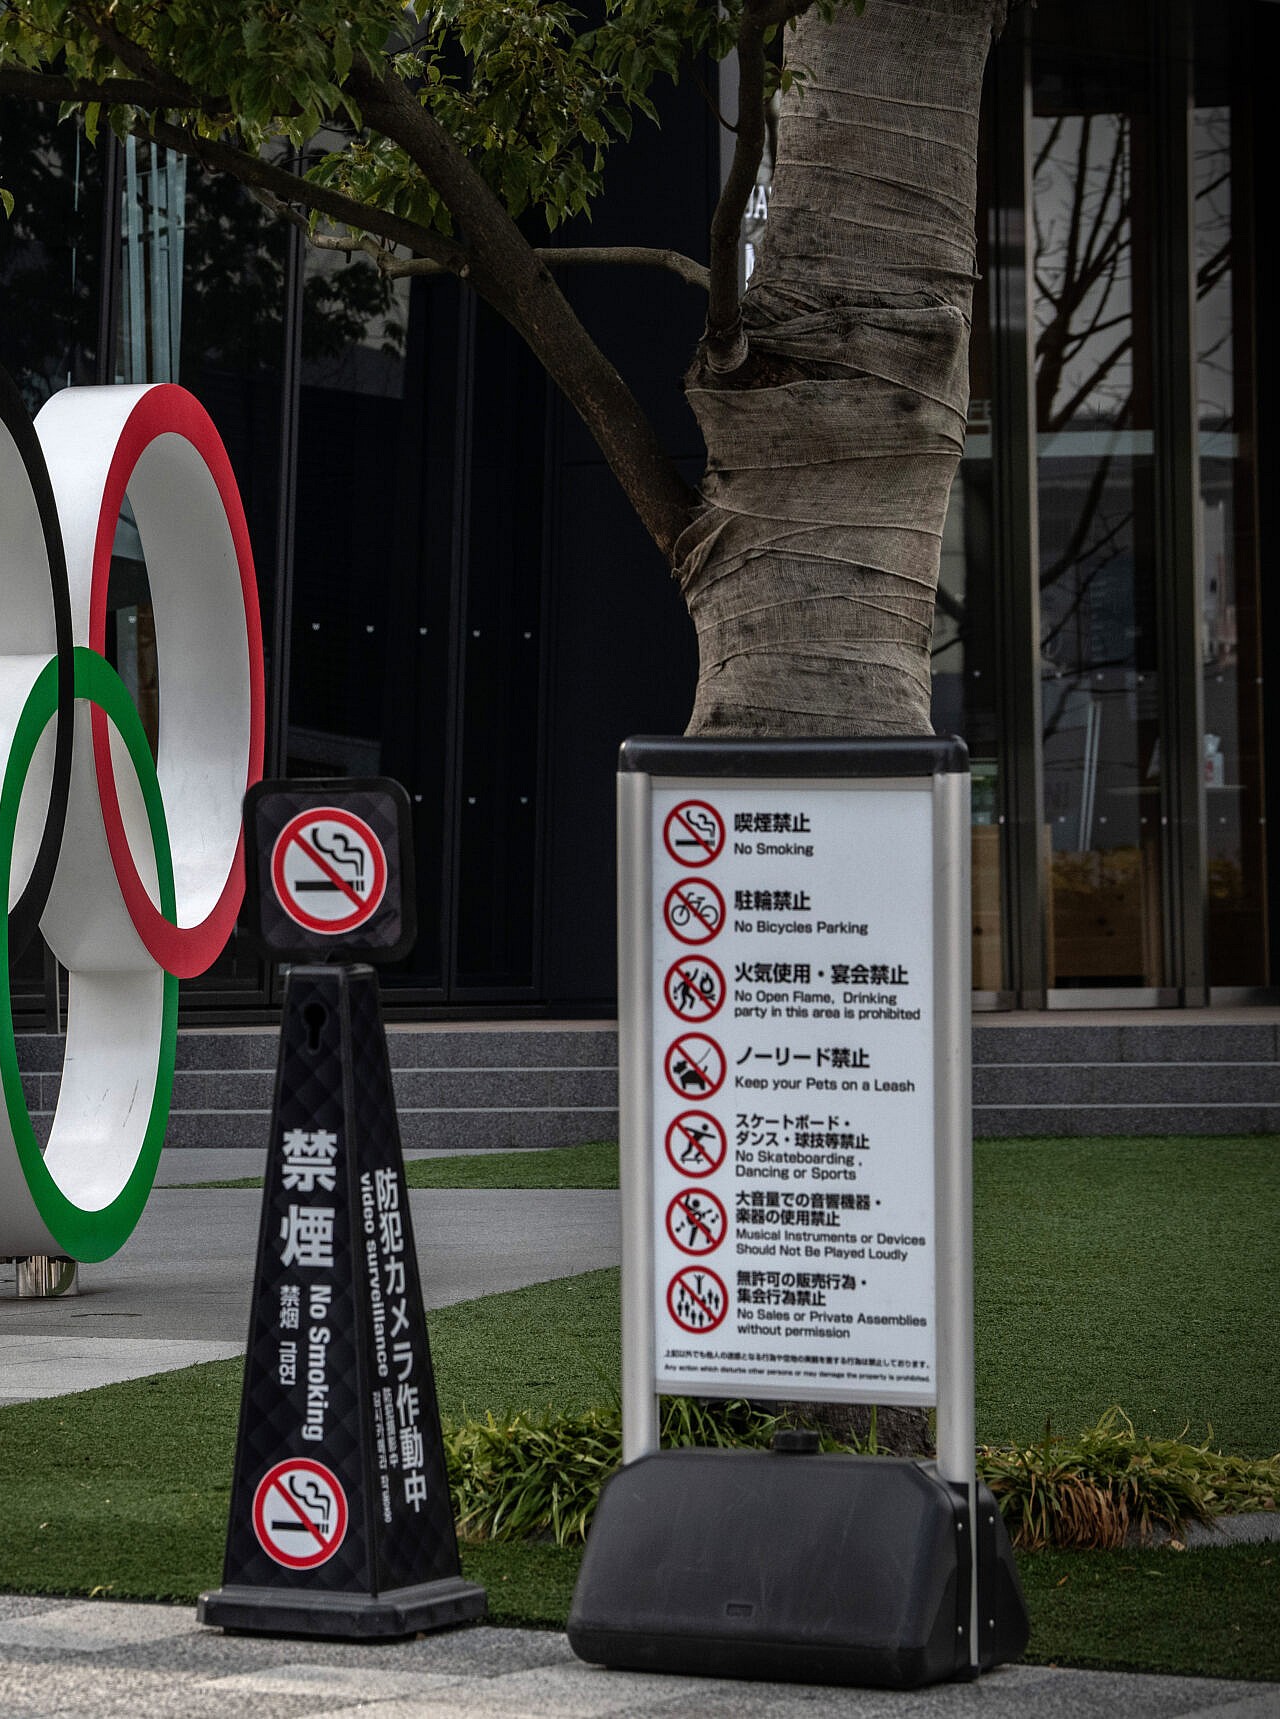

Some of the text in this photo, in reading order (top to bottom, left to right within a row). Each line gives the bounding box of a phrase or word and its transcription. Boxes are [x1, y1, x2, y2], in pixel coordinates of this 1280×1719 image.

[734, 813, 811, 834] 喫煙禁止
[734, 843, 814, 857] No Smoking
[734, 890, 811, 912] 駐輪禁止
[734, 921, 868, 936] No Bicycles Parking
[734, 963, 909, 986] 火気使用・宴会禁止
[734, 991, 897, 1006] No Open Flame, Drinking
[734, 1006, 920, 1021] party in this area is prohibited
[735, 1047, 870, 1068] ノーリード禁止
[735, 1077, 915, 1092] Keep your Pets on a Leash
[735, 1114, 850, 1130] スケートボード・
[735, 1132, 869, 1149] ダンス・球技等禁止
[735, 1151, 754, 1162] No
[735, 1166, 856, 1181] Dancing or Sports
[280, 1128, 338, 1267] 禁煙
[735, 1209, 840, 1227] 楽器の使用禁止
[736, 1230, 926, 1246] Musical Instruments or Devices
[736, 1244, 907, 1262] Should Not Be Played Loudly
[736, 1270, 867, 1290] 無許可の販売行為・
[736, 1288, 826, 1307] 集会行為禁止
[366, 1239, 389, 1378] surveillance
[738, 1309, 927, 1328] No Sales or Private Assemblies
[375, 1167, 427, 1513] 防犯カメラ作動中
[738, 1324, 850, 1339] without permission
[301, 1284, 332, 1441] No Smoking
